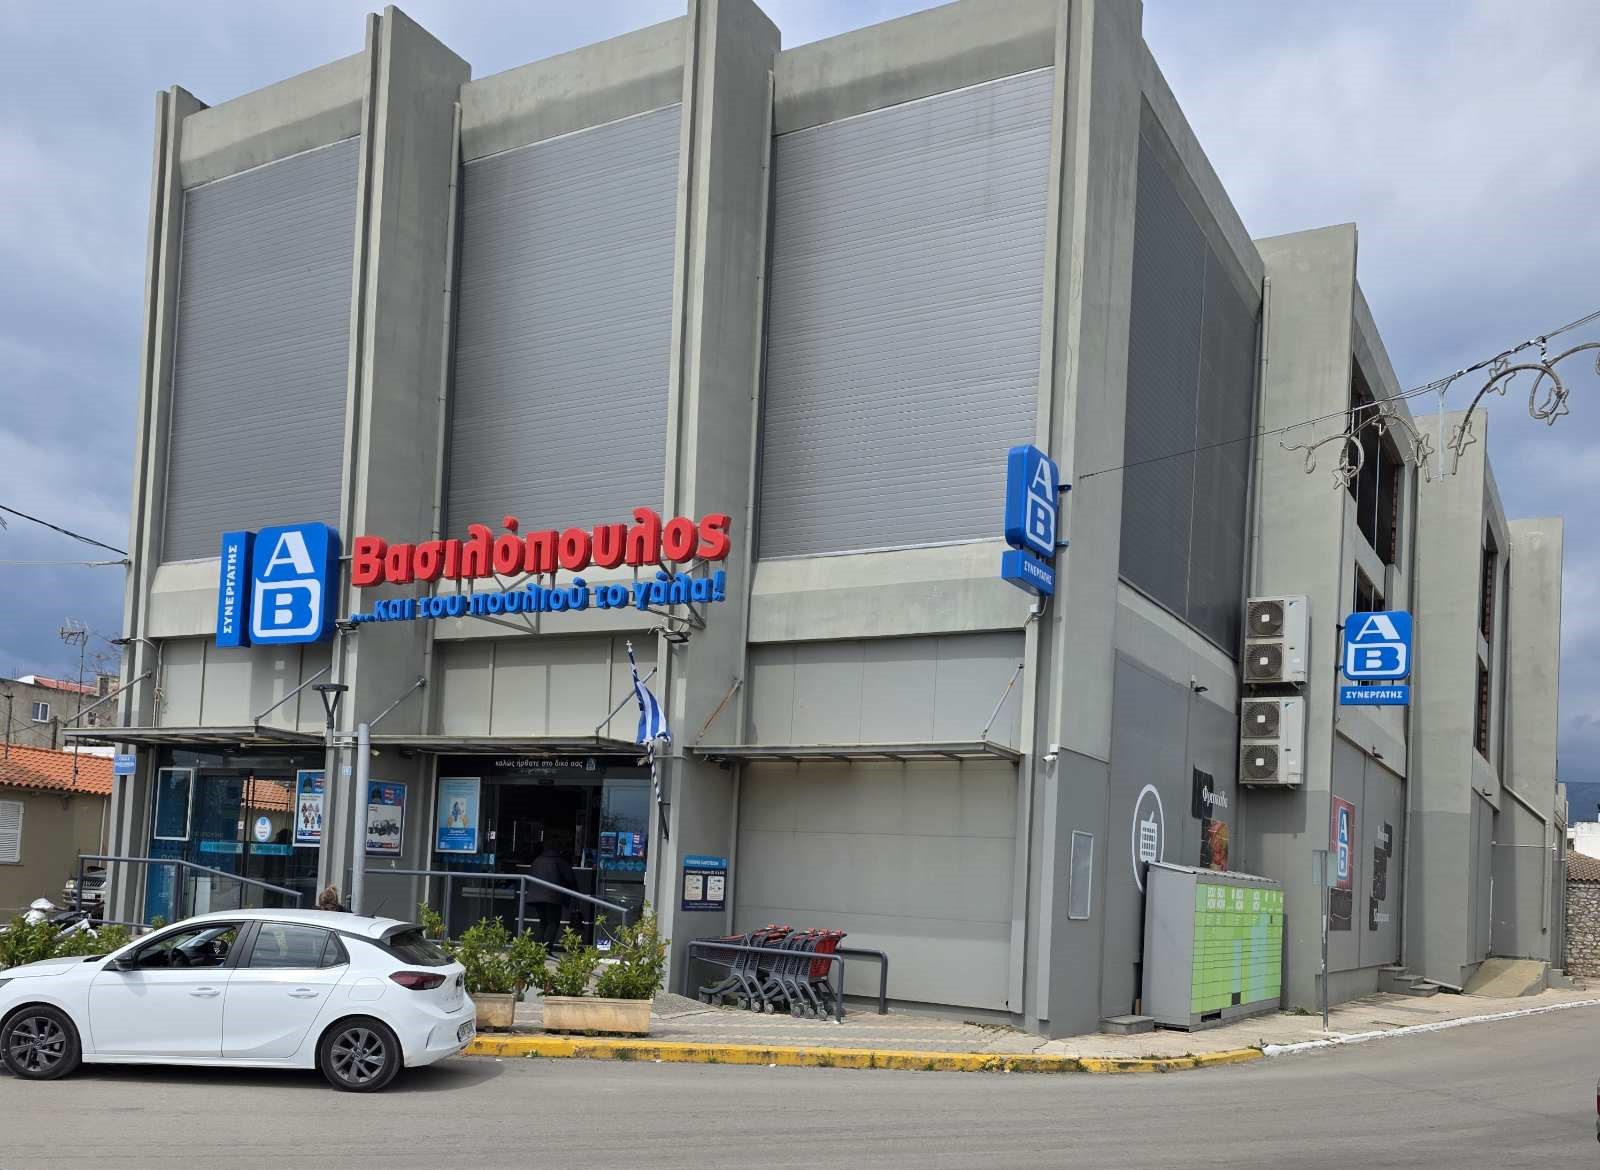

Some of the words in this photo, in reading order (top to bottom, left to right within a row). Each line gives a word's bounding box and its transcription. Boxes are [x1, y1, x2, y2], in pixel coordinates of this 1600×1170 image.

[352, 506, 731, 586] Βασιλόπουλος
[223, 544, 238, 634] ΣΥΝΕΡΓΑΤΗΣ
[419, 595, 467, 619] του
[470, 576, 590, 616] πουλιού
[594, 584, 629, 610] το
[632, 568, 727, 611] γάλα!
[1024, 560, 1053, 585] ΣΥΝΕΡΓΑΤΗΣ
[1345, 690, 1403, 699] ΣΥΝΕΡΓΑΤΗΣ
